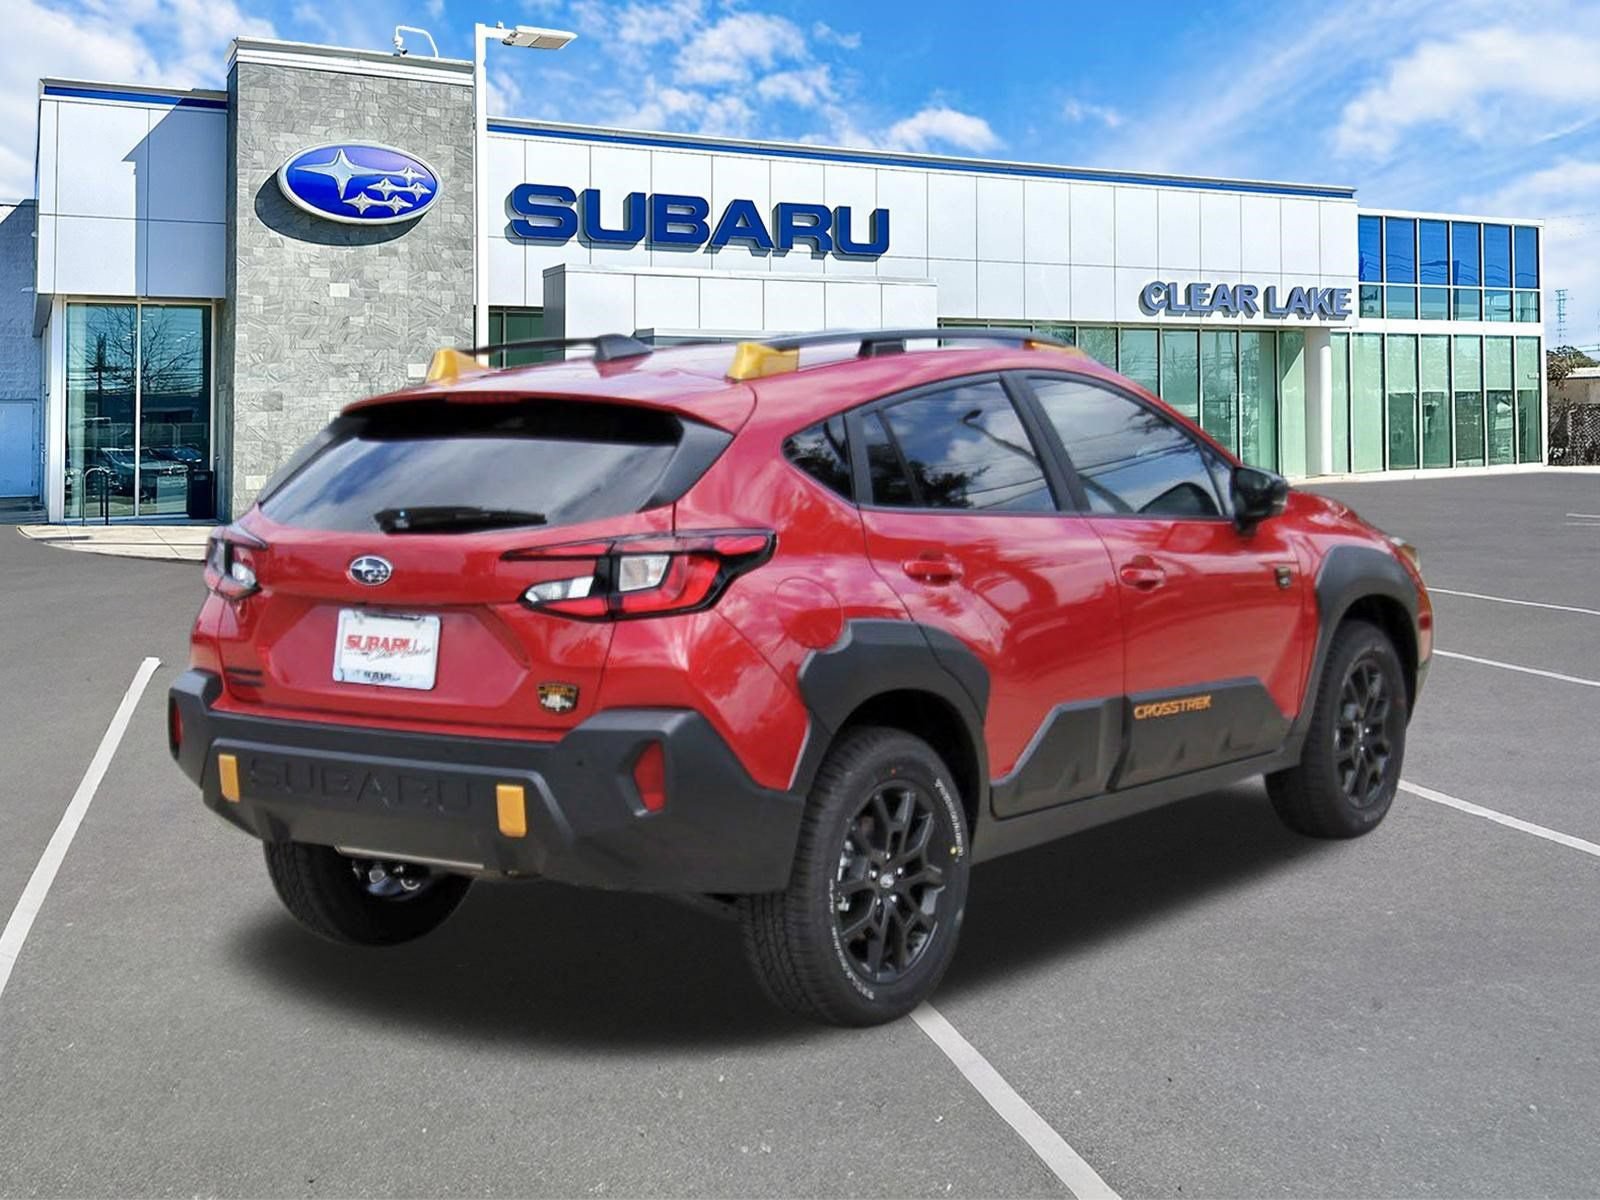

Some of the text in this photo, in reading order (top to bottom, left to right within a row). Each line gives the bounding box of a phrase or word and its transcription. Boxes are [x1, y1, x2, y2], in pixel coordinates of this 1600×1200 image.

[505, 182, 890, 262] SUBARU
[1140, 281, 1353, 320] CLEAR LAKE
[249, 756, 474, 815] SUBARU
